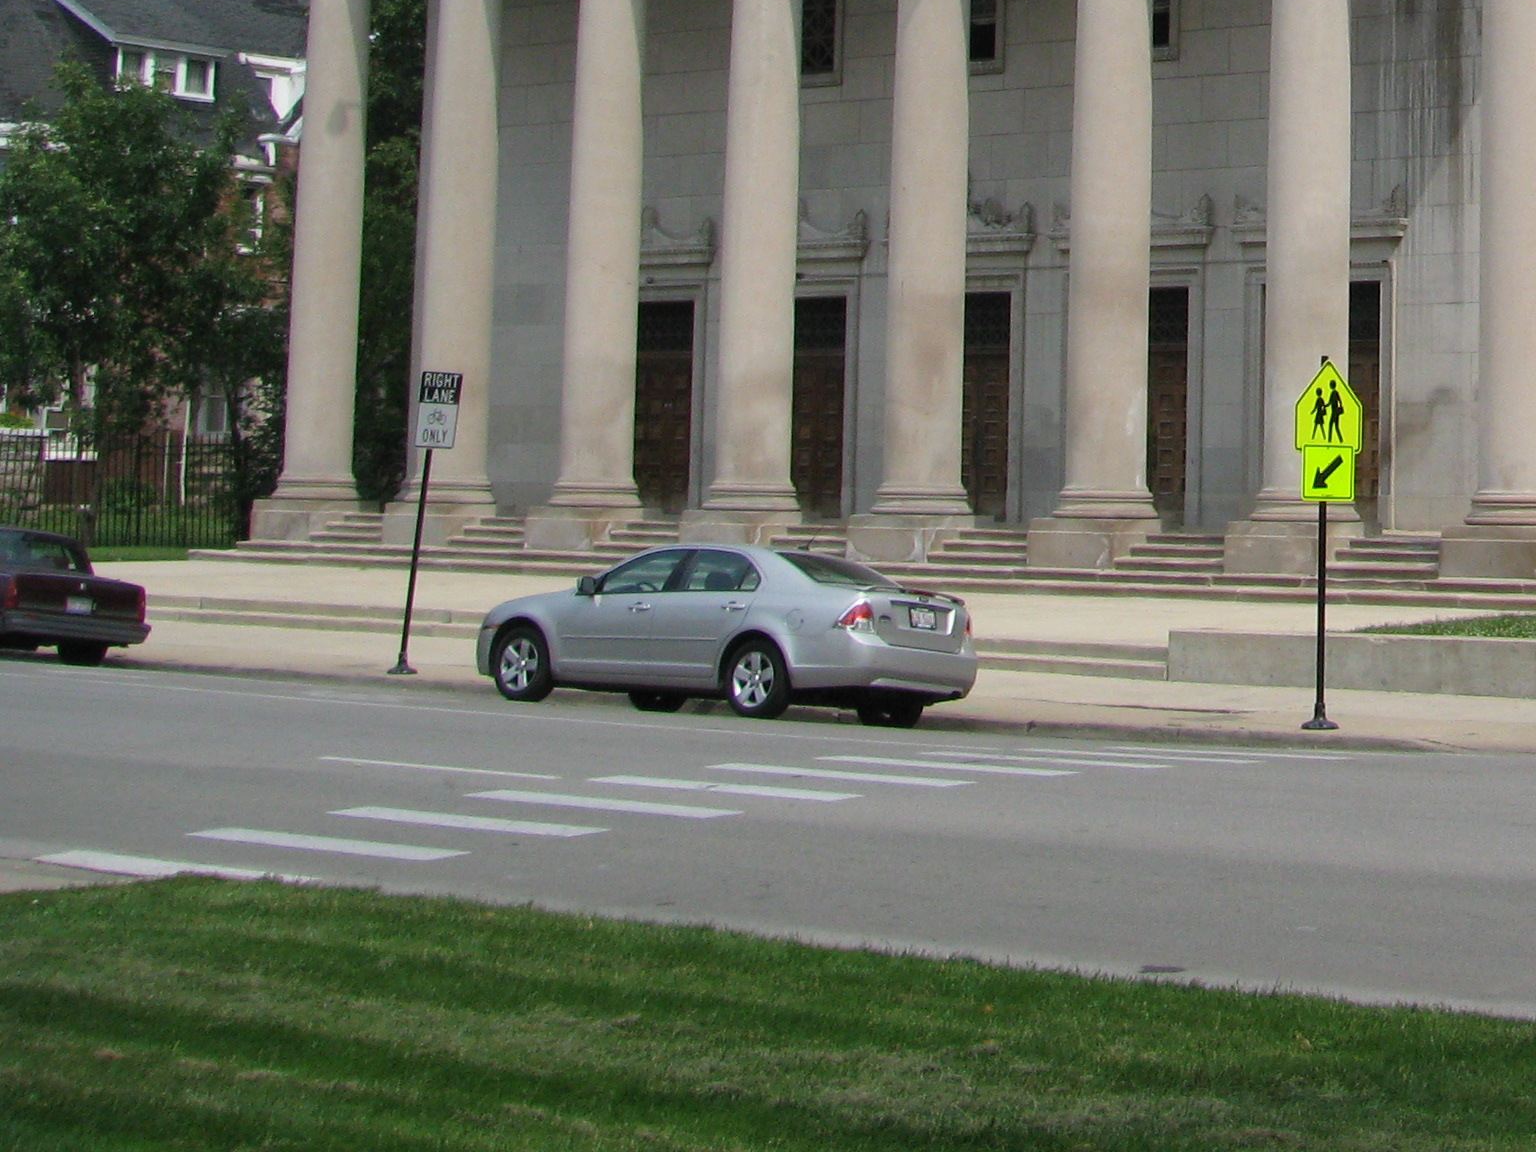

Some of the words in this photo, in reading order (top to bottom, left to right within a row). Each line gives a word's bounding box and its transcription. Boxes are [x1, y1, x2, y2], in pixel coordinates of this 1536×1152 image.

[424, 373, 459, 387] RIGHT
[425, 388, 456, 403] LANE
[422, 428, 448, 443] ONLY
